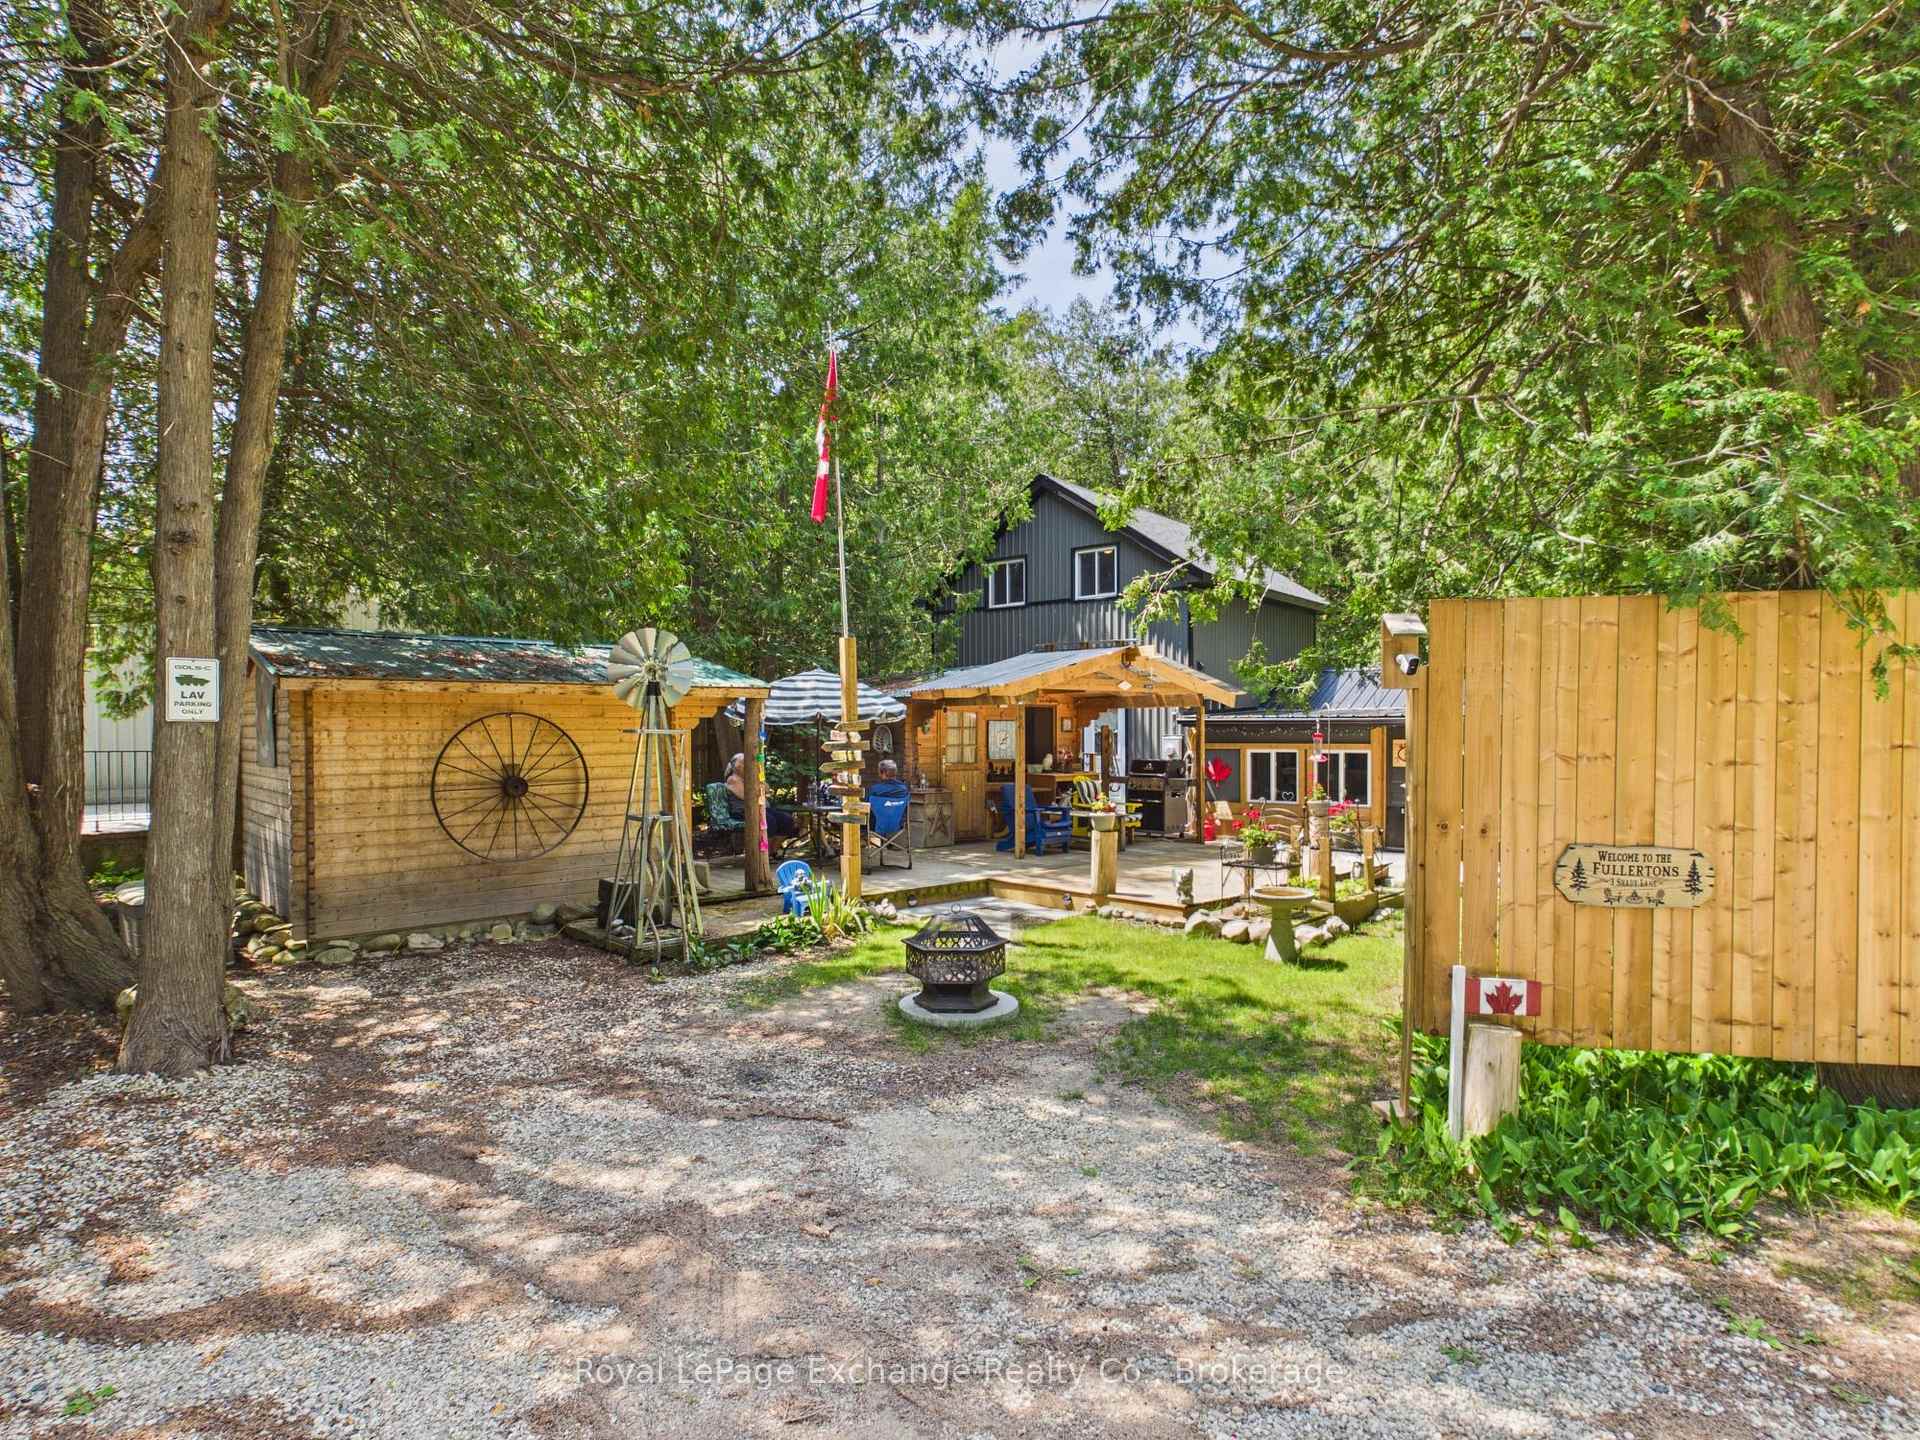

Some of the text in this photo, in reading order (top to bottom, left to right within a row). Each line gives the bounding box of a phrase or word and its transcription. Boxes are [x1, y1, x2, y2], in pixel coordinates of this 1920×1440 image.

[180, 691, 205, 699] LAV
[1642, 853, 1653, 863] TO
[1656, 853, 1672, 863] THE
[1593, 862, 1680, 877] FULLERTONS
